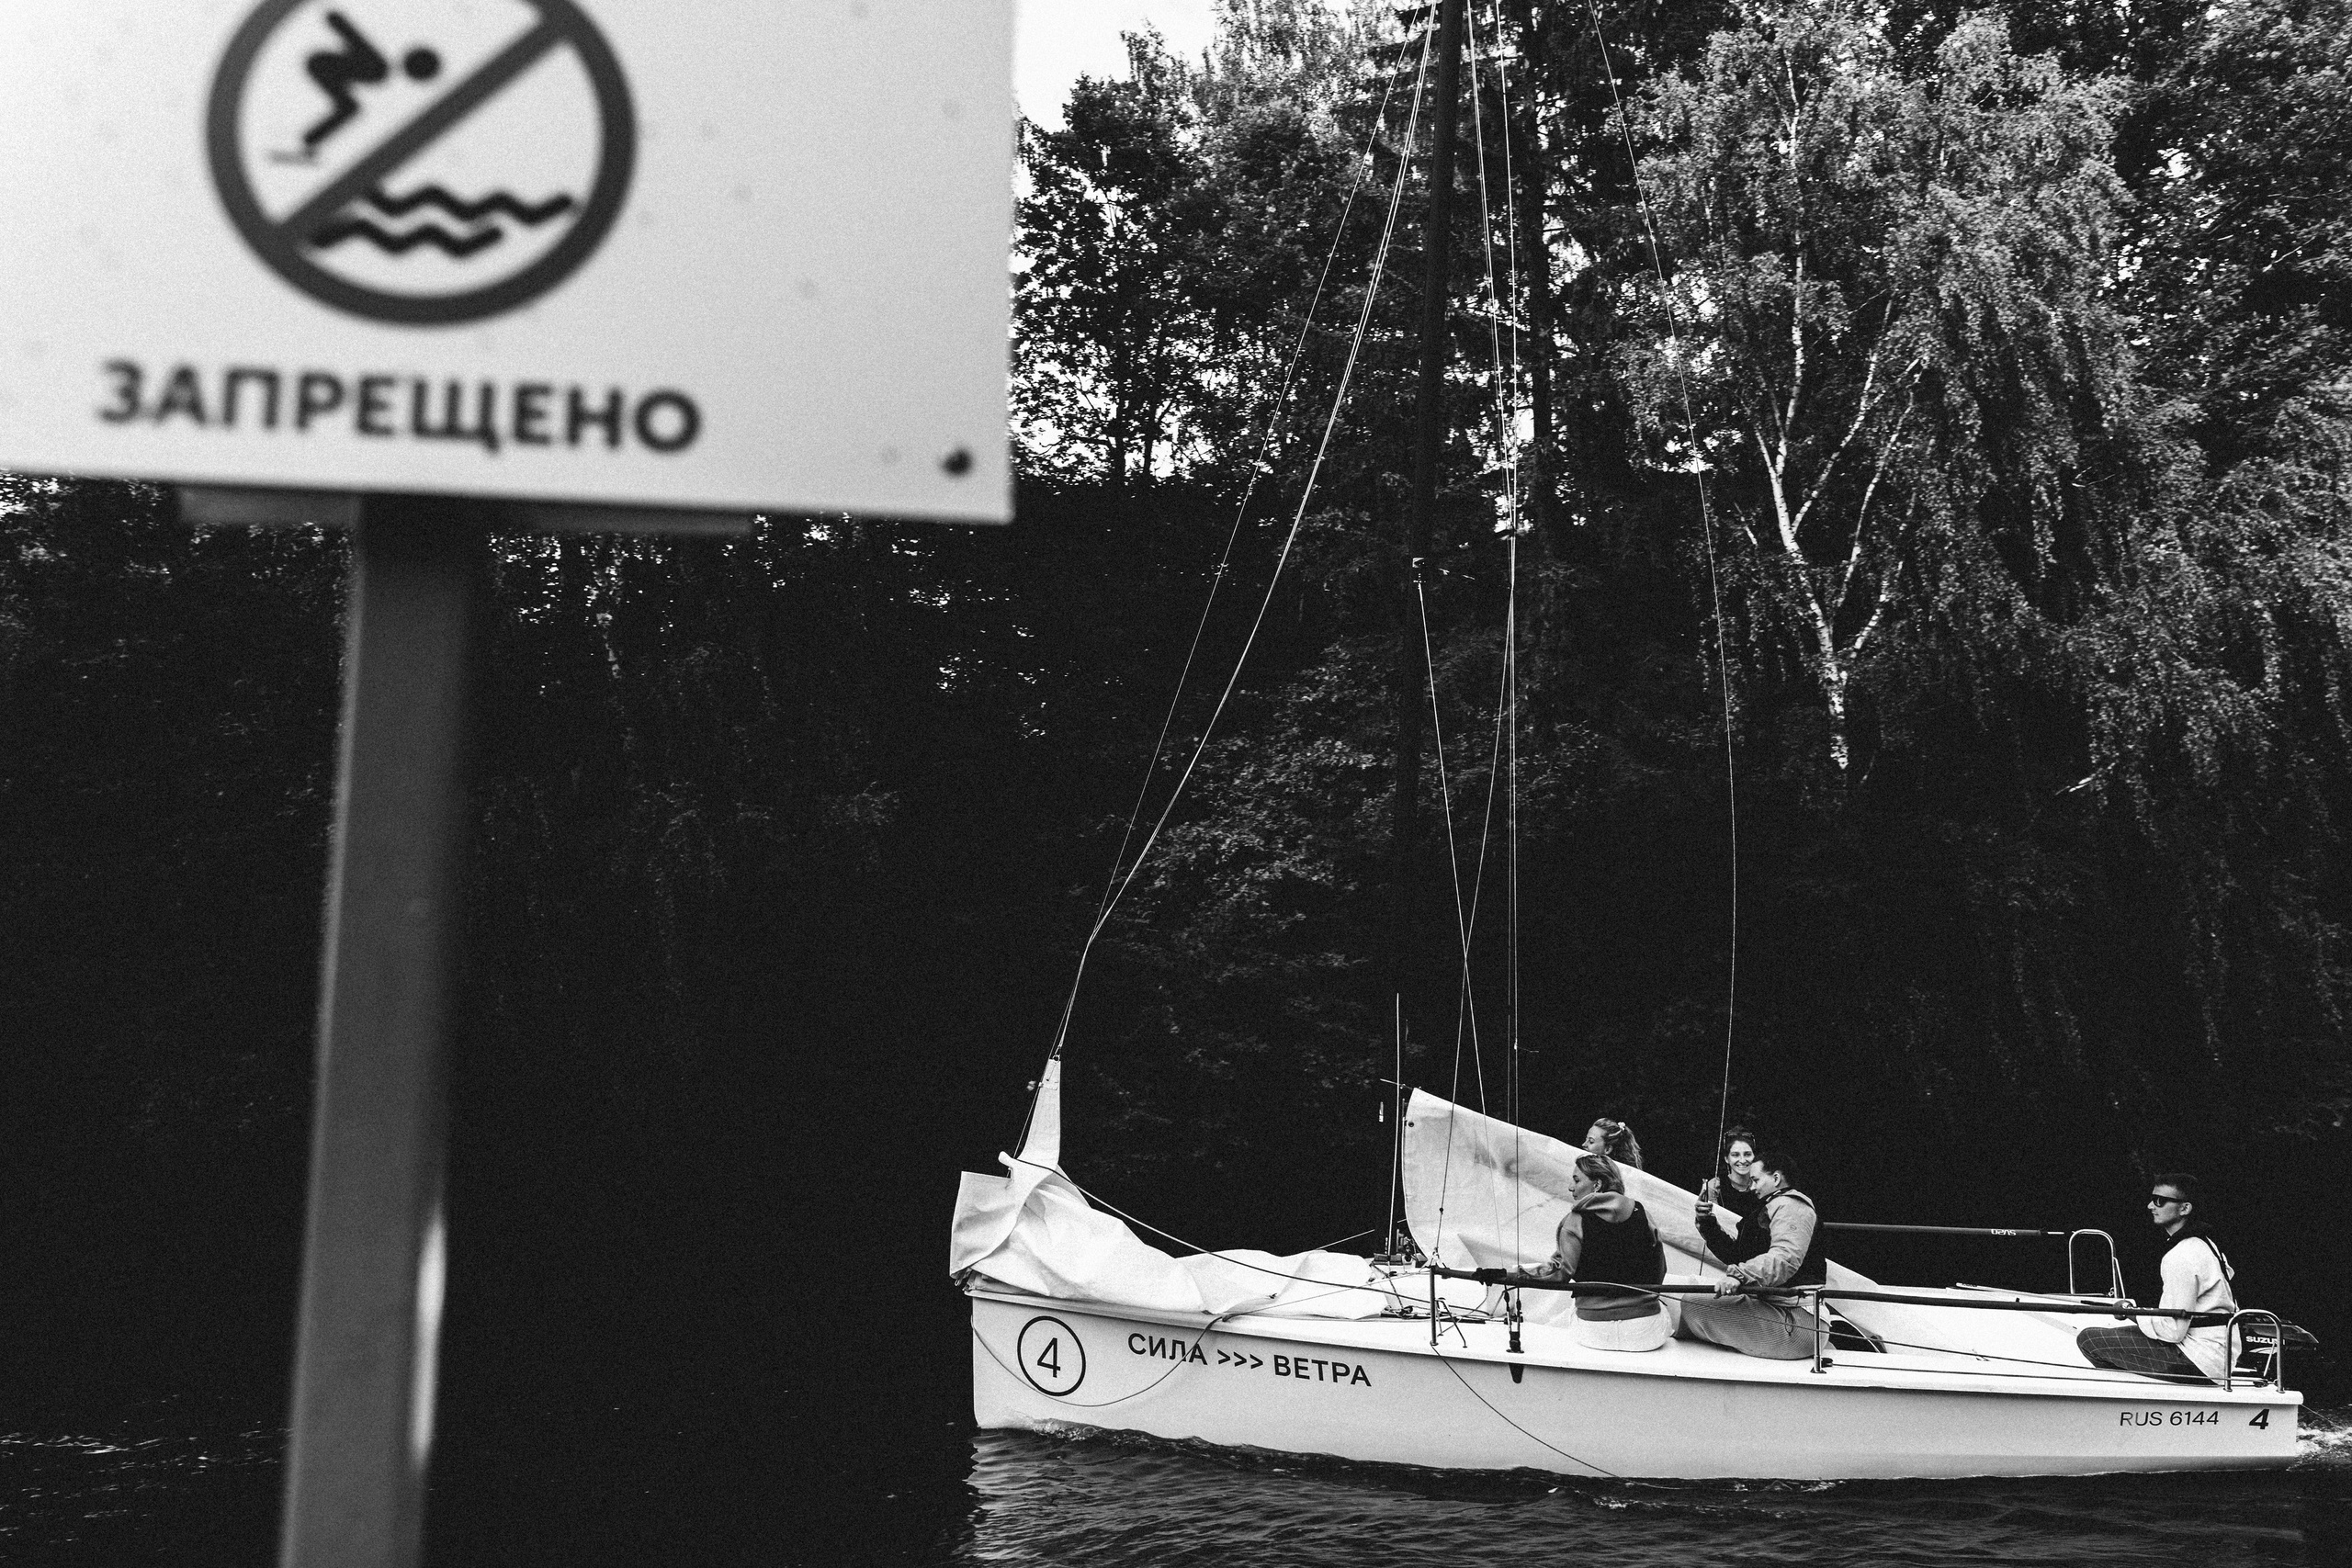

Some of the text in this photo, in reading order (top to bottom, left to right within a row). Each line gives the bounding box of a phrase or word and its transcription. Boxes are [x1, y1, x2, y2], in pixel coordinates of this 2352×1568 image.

[97, 357, 702, 455] ЗАПРЕЩЕНО
[1036, 1337, 1062, 1378] 4
[1127, 1332, 1208, 1366] СИЛА
[1273, 1353, 1373, 1388] ВЕТРА
[2119, 1410, 2220, 1427] RUS 6144
[2248, 1408, 2270, 1429] 4
